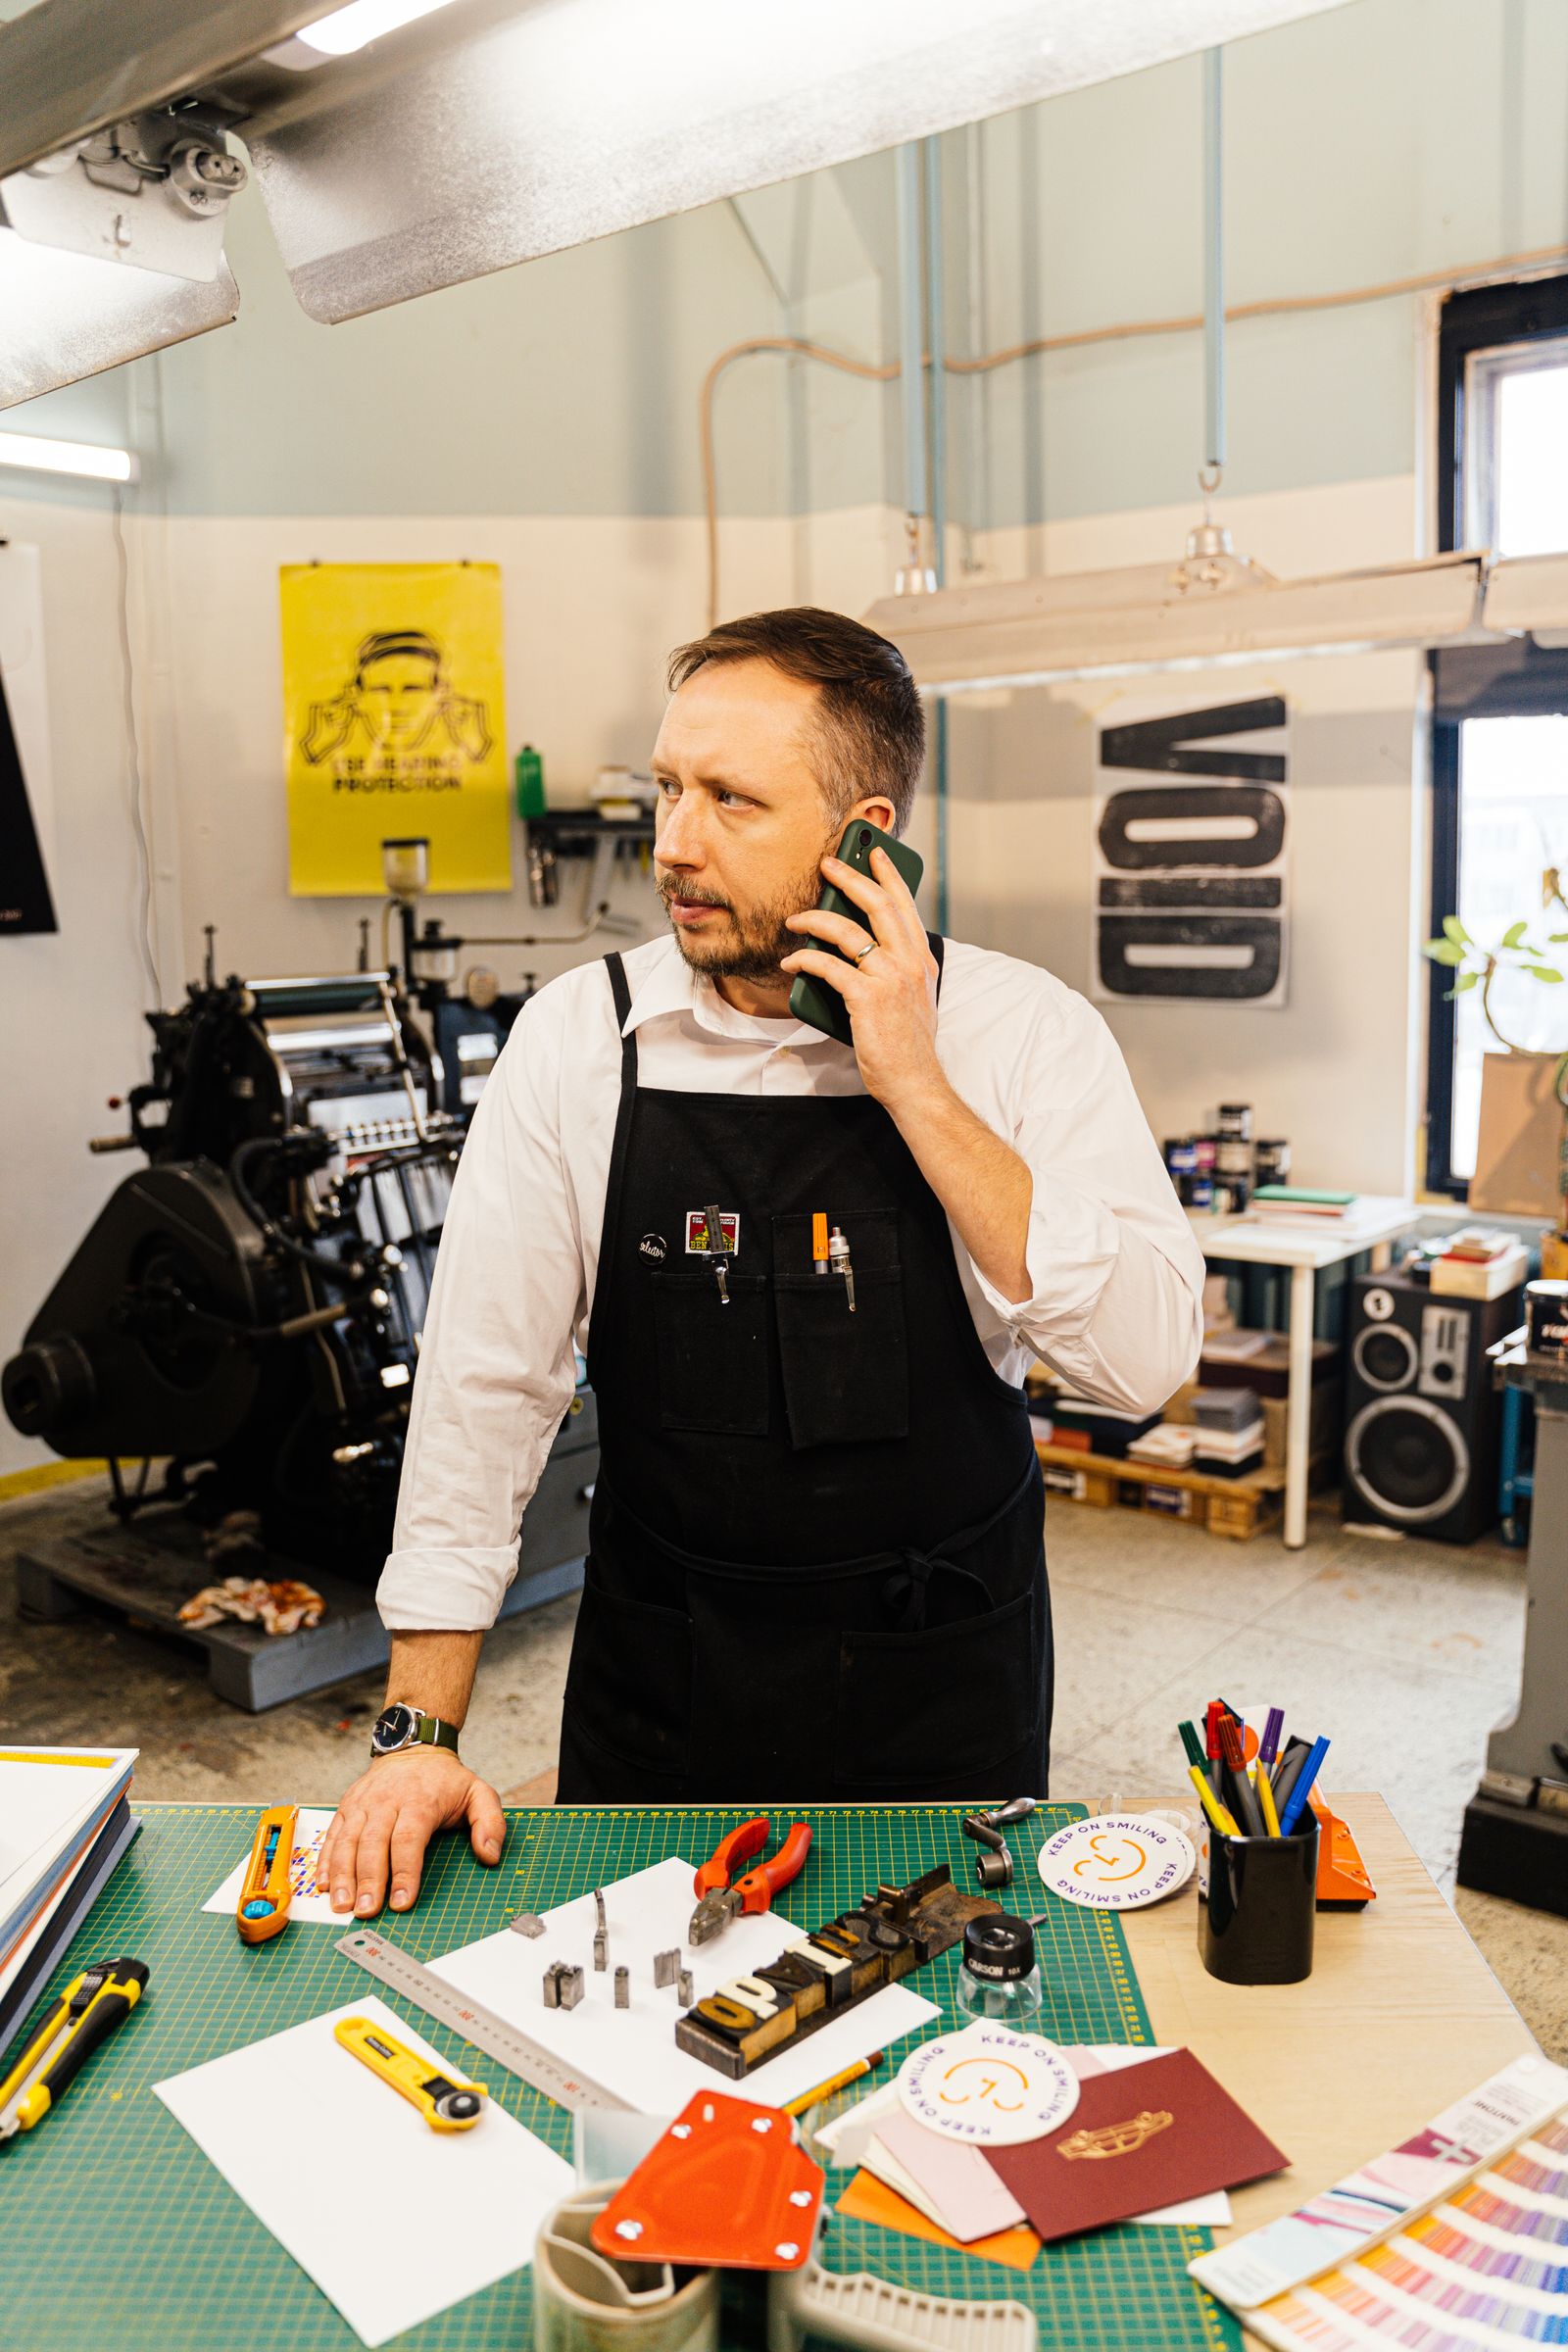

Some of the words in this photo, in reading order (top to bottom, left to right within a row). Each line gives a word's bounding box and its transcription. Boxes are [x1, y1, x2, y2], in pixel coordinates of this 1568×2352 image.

[1048, 1832, 1073, 1856] KEEP
[1078, 1823, 1100, 1833] ON
[1106, 1822, 1167, 1844] SMILING
[1154, 1863, 1177, 1889] KEEP
[1057, 1880, 1121, 1902] SMILING
[1128, 1888, 1151, 1900] ON
[968, 1958, 1004, 1976] CARSON
[981, 2034, 1030, 2048] KEEP
[1034, 2049, 1056, 2066] ON
[908, 2046, 945, 2095] SMILING
[1038, 2069, 1069, 2121] SMILING
[916, 2099, 937, 2117] ON
[940, 2119, 991, 2134] KEEP
